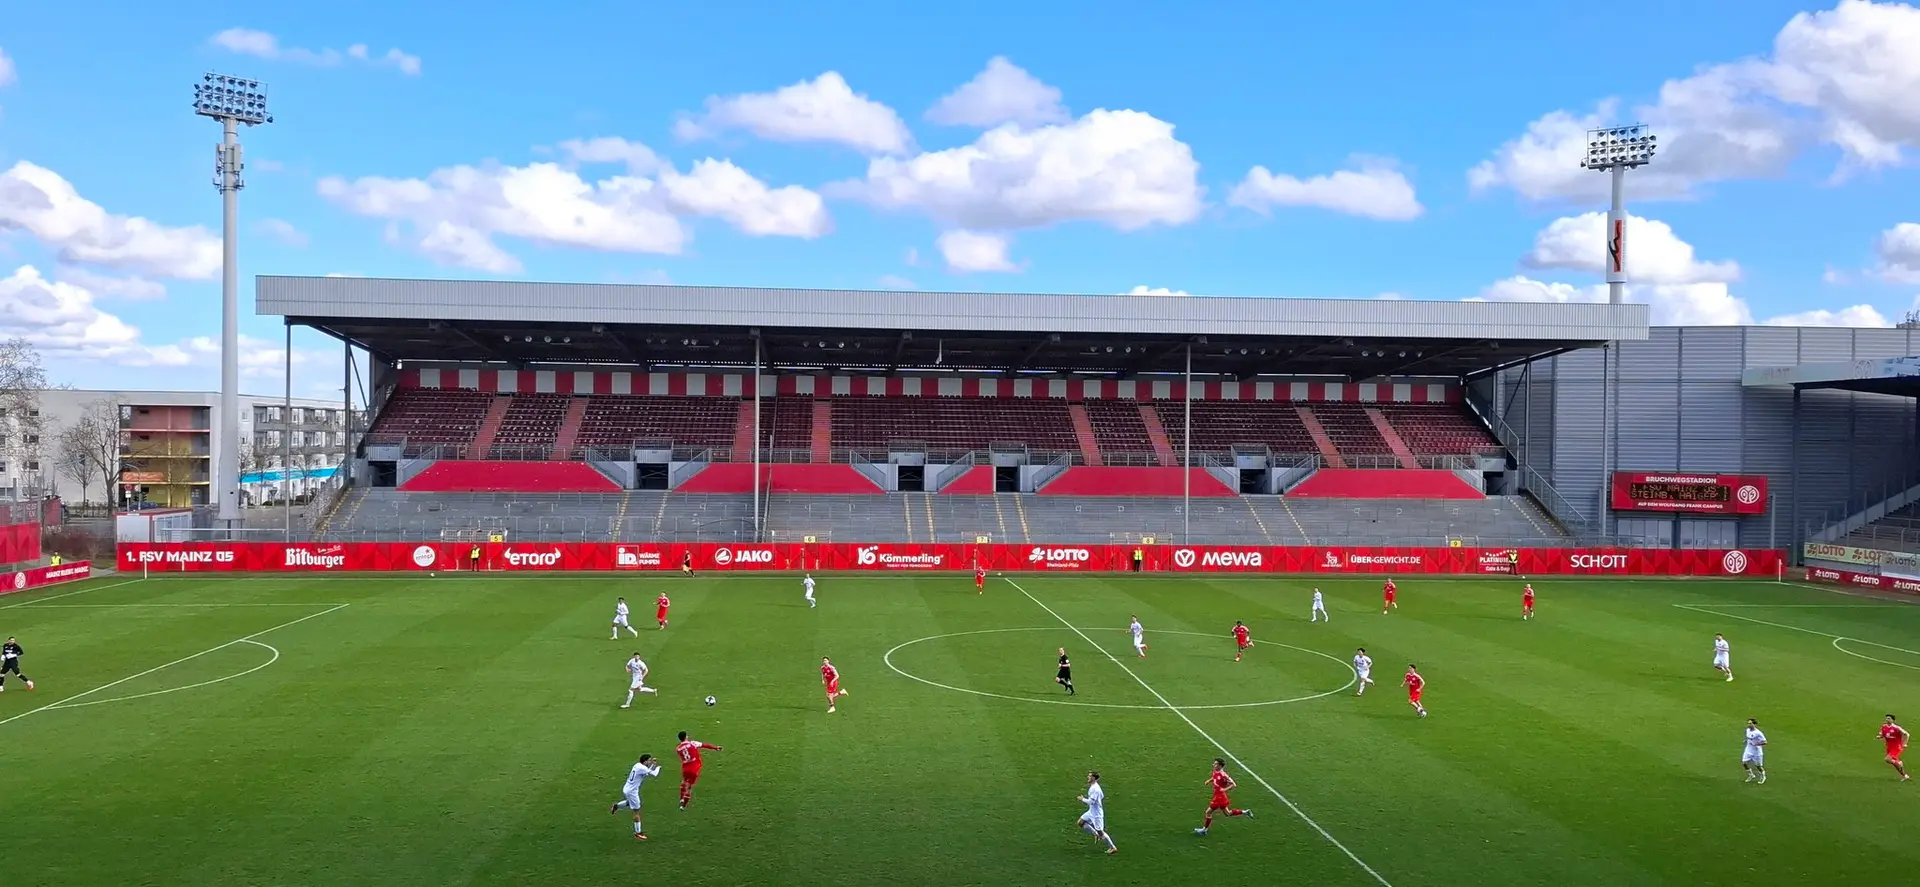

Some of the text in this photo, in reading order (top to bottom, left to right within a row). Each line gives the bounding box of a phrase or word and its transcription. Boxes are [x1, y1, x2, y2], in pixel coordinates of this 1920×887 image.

[1645, 476, 1717, 486] BRUCHWEGSTADION
[126, 551, 234, 562] 1. FSV MAINZ 05
[1047, 549, 1089, 561] LOTTO
[1818, 545, 1846, 557] LOTTO
[285, 548, 345, 568] Bitburger
[639, 553, 660, 561] WÄRME
[735, 551, 772, 563] JAKO
[880, 553, 941, 565] Kömmerling
[1350, 554, 1421, 564] ÜBER-GEWICHT.DE
[1570, 555, 1627, 568] SCHOTT
[1895, 557, 1917, 567] LOTTO
[1821, 571, 1840, 580] LOTTO
[1860, 575, 1880, 585] LOTTO
